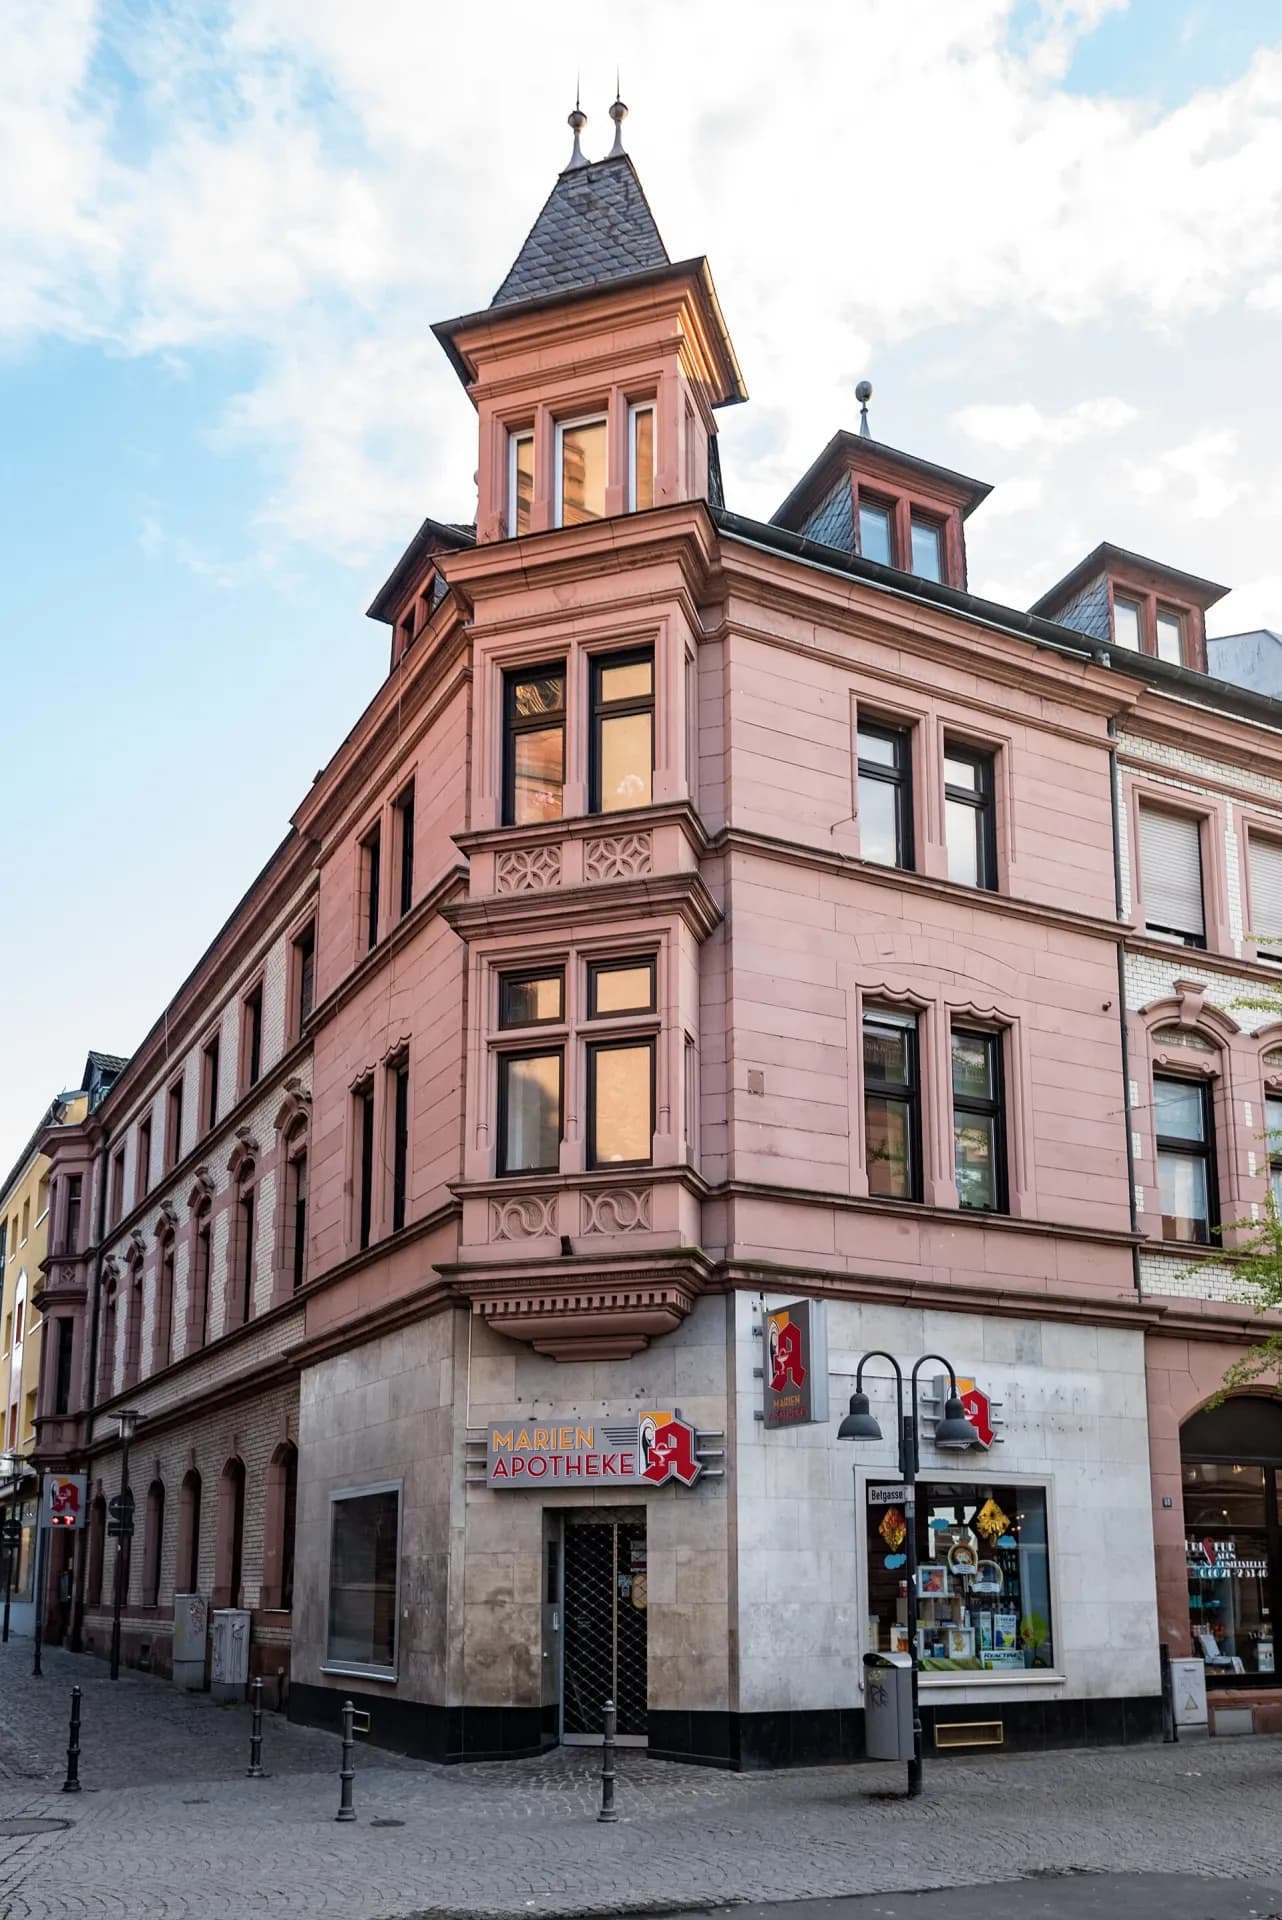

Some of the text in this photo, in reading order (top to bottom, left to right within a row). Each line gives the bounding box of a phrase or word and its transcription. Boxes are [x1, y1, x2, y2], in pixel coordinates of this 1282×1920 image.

[492, 1426, 594, 1452] MARIEN
[491, 1453, 635, 1479] APOTHEKE
[871, 1490, 904, 1503] Betgasse
